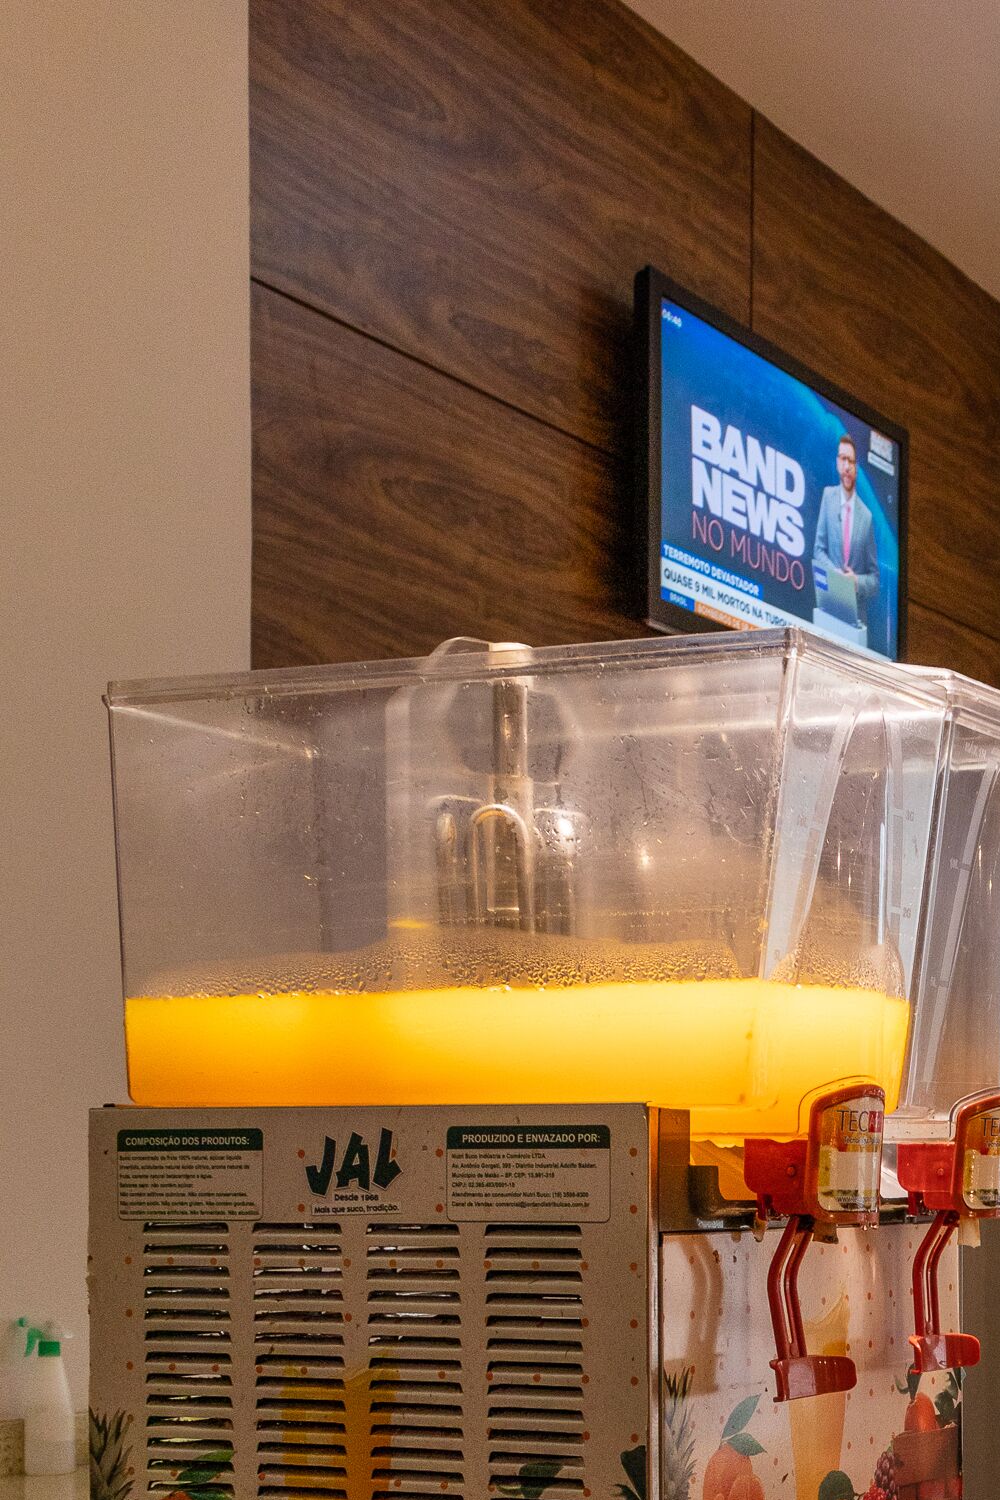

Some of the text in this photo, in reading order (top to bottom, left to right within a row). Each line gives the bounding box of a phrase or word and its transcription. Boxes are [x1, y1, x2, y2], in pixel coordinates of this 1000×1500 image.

[691, 405, 805, 508] BAND
[692, 457, 805, 557] NEWS
[663, 544, 760, 597] TERREMOTO DEVASTADOR
[692, 510, 724, 551] NO
[731, 529, 805, 590] MUNDO
[663, 568, 693, 590] QUASE
[694, 582, 700, 593] 9
[701, 584, 715, 600] MIL
[717, 589, 750, 615] MORTOS
[752, 607, 764, 621] NA
[125, 1136, 250, 1147] COMPOSIÇÃO DOS PRODUTOS:
[304, 1126, 404, 1198] JAL
[462, 1133, 600, 1143] PRODUZIDO E ENVAZADO POR:
[331, 1207, 345, 1215] que
[347, 1205, 366, 1213] suco,
[367, 1203, 400, 1213] tradição.
